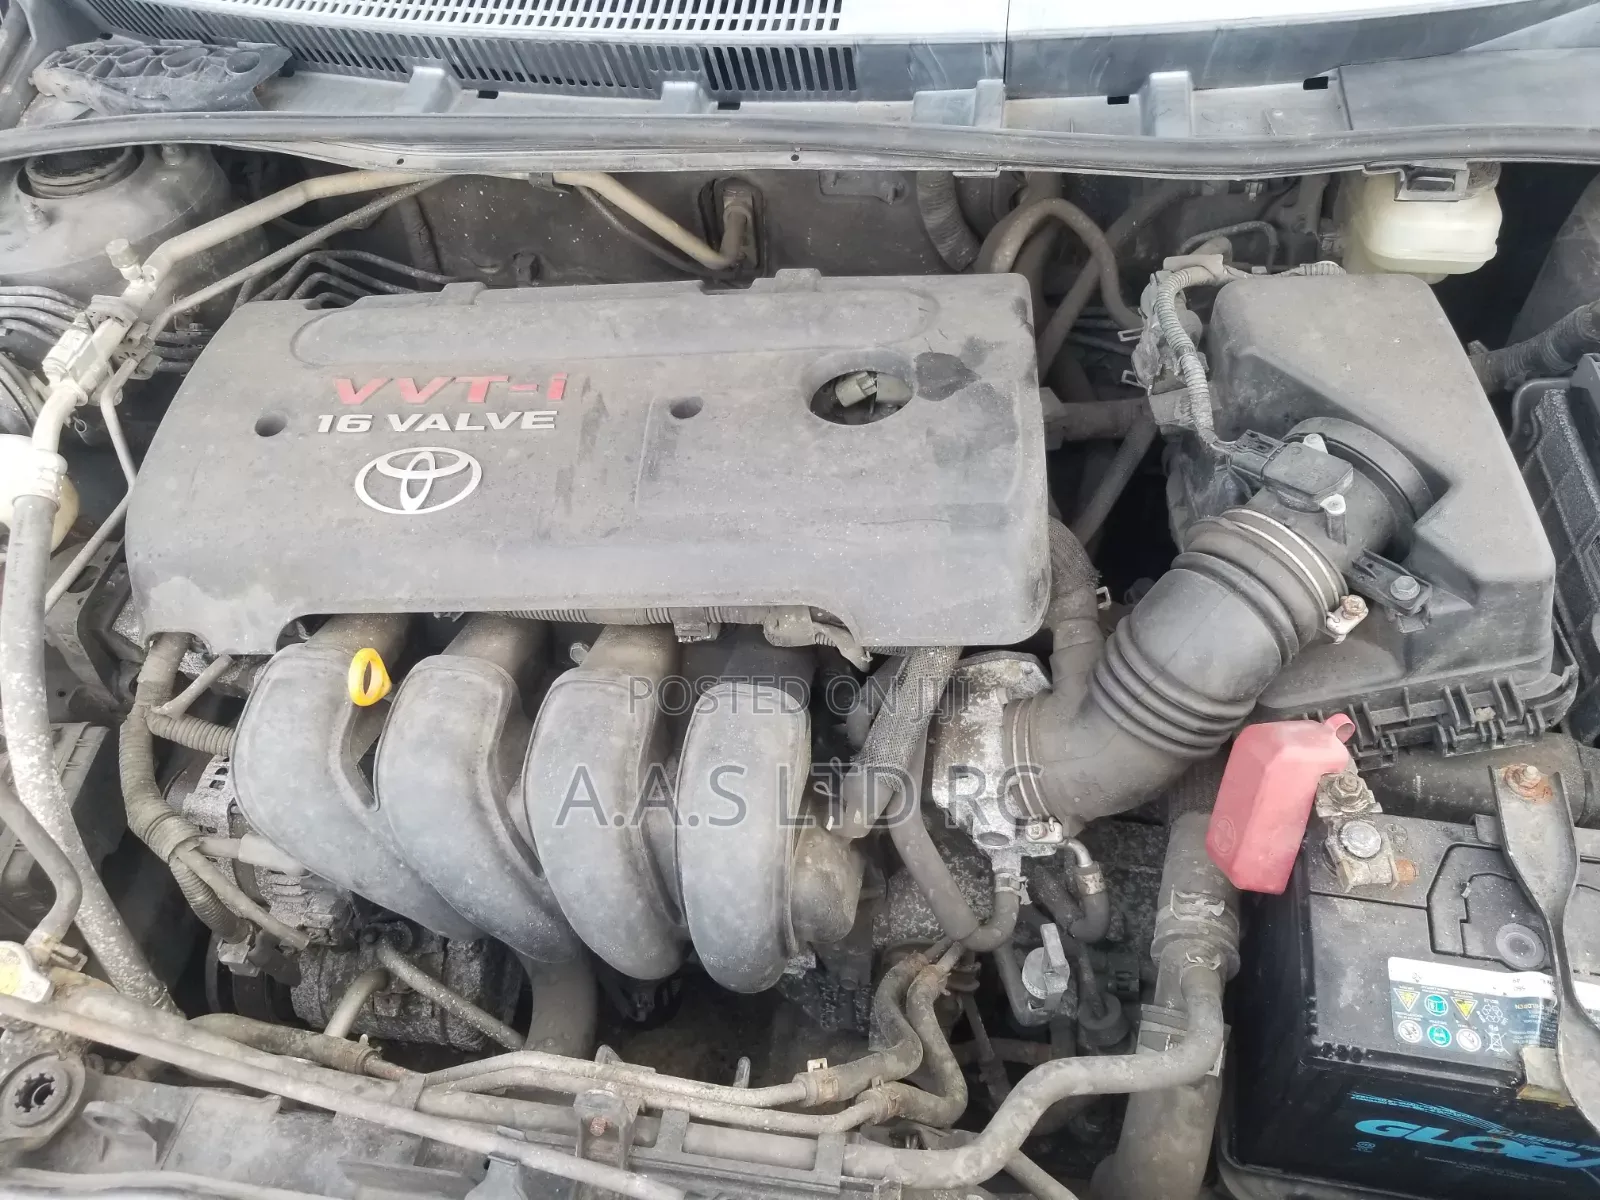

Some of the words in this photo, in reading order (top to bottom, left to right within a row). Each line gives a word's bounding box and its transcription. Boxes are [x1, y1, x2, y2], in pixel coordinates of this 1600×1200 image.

[334, 373, 567, 405] VVT-i
[317, 414, 373, 433] 16
[387, 411, 557, 432] VALVE
